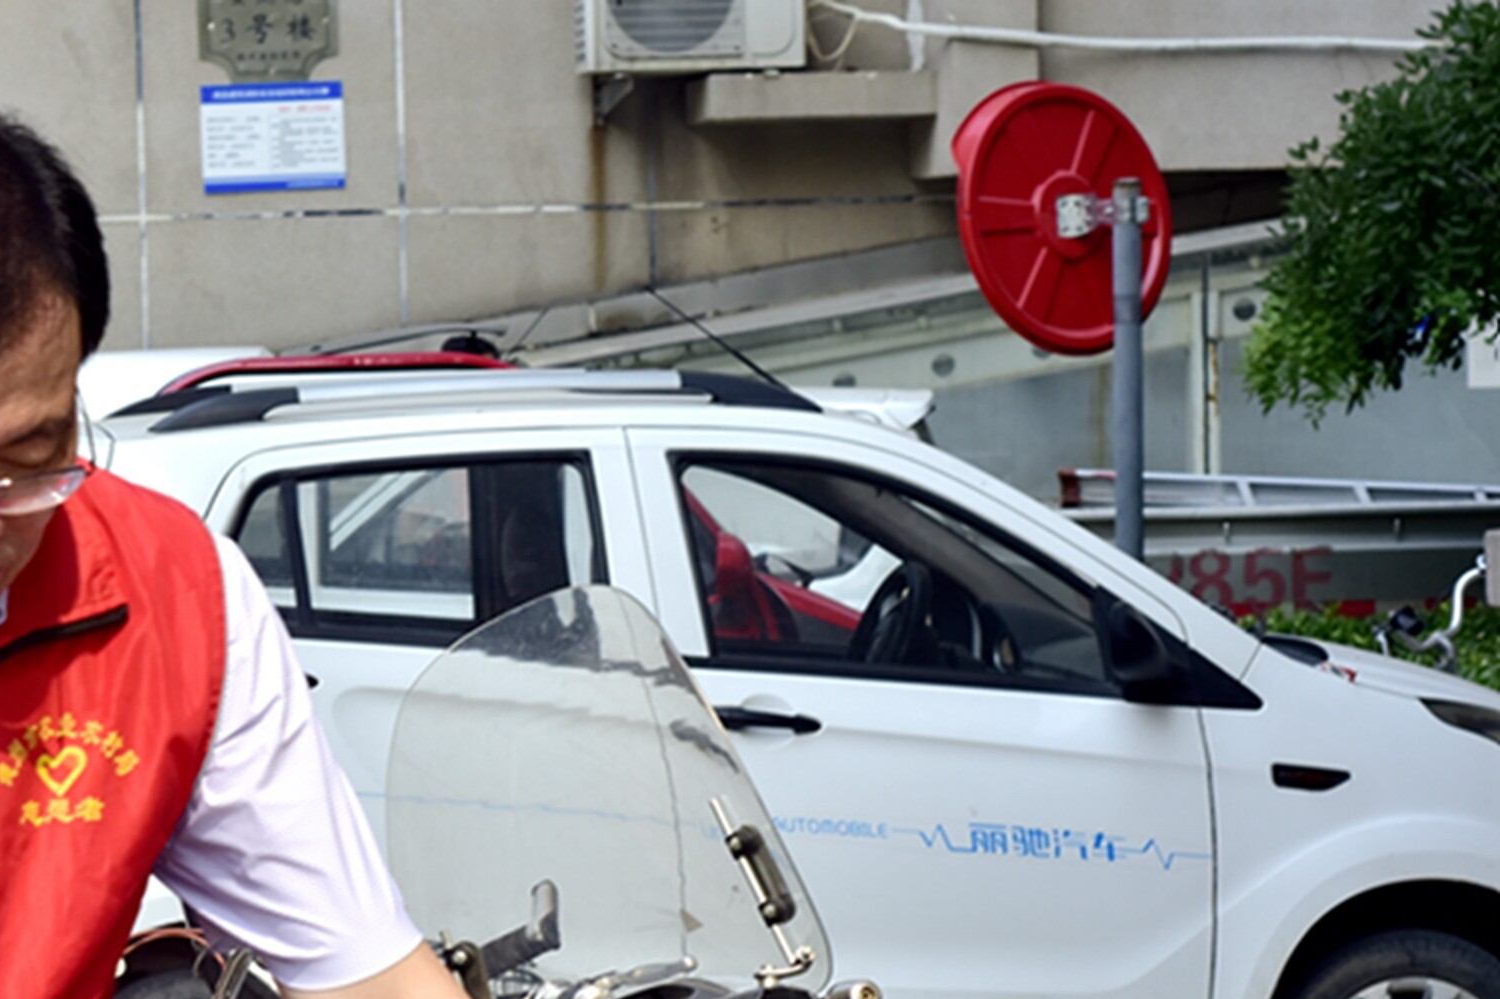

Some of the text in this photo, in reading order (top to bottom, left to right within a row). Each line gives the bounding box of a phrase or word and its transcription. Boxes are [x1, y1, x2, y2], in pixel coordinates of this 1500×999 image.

[1167, 546, 1332, 616] 85E
[18, 796, 105, 827] 志愿者
[772, 815, 888, 839] AUTOMOBILE
[968, 821, 1127, 862] 丽驰汽车
